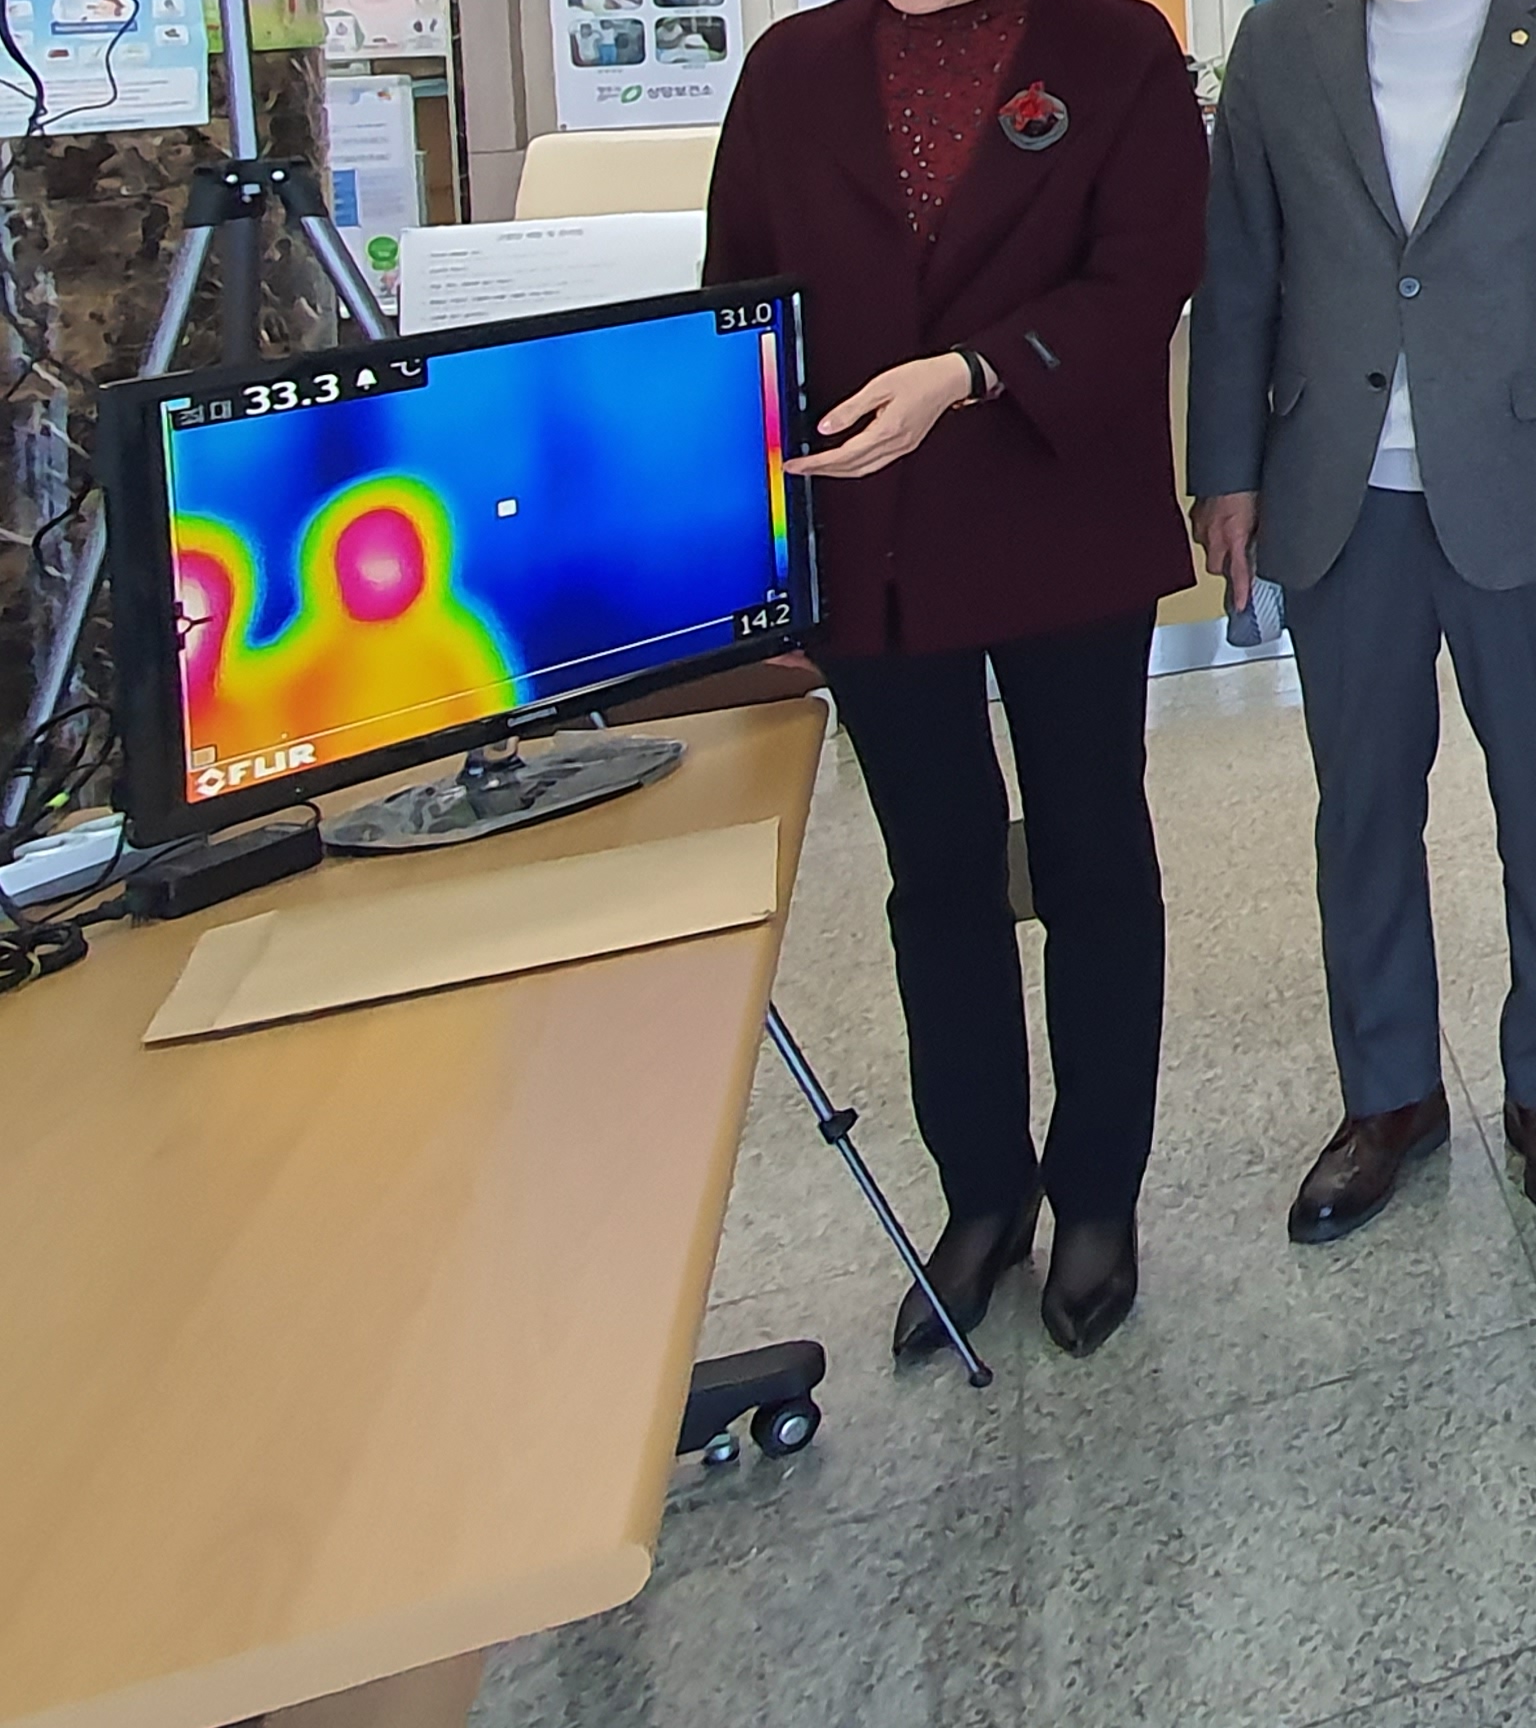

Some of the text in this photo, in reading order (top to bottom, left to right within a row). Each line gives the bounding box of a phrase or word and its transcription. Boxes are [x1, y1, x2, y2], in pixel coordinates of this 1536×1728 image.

[720, 303, 772, 329] 31.0
[243, 373, 341, 415] 33.3
[741, 604, 790, 635] 14.2
[228, 743, 317, 785] FLIR
